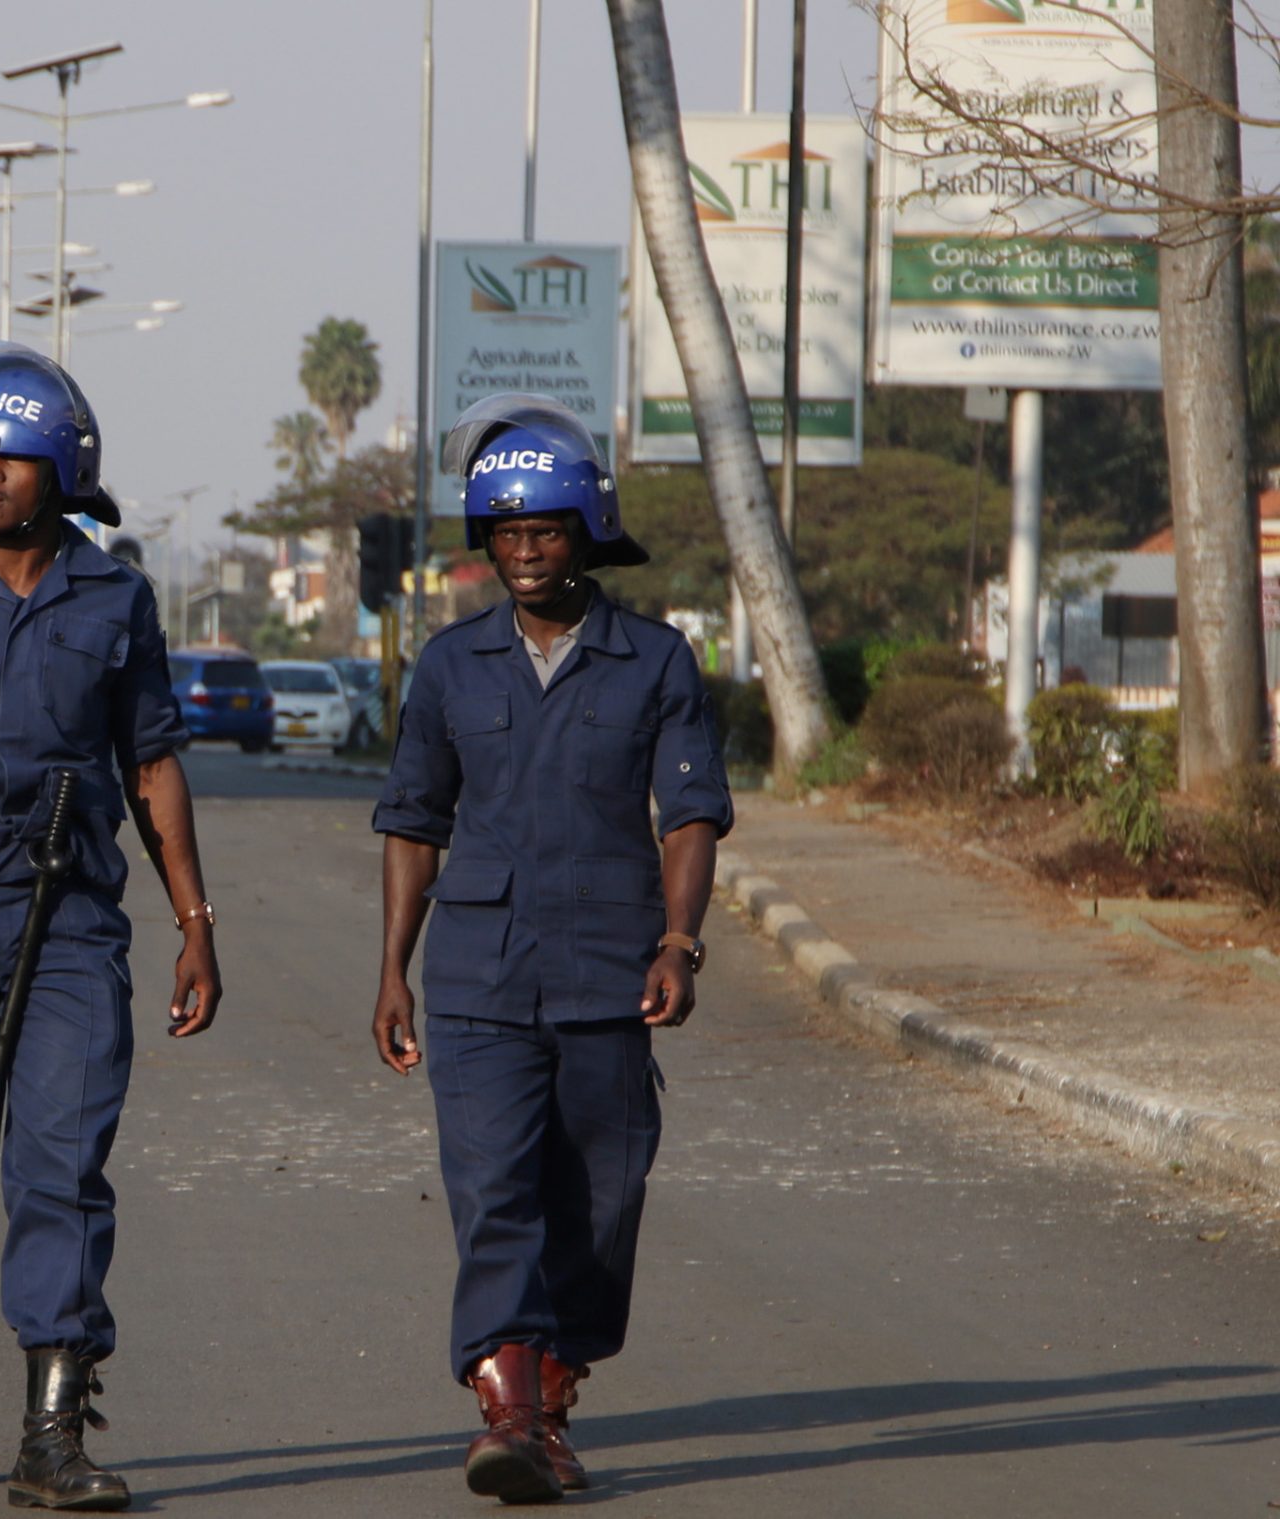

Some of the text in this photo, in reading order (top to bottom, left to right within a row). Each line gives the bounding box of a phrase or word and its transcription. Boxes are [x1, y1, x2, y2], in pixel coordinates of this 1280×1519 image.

[1109, 90, 1133, 117] &
[730, 161, 833, 210] THI
[930, 243, 1010, 267] Contact
[1016, 244, 1063, 268] Your
[513, 268, 588, 304] THI
[932, 270, 1139, 297] or Contact Us Direct
[468, 348, 560, 369] Agricultural
[458, 370, 589, 389] General Insurers
[471, 450, 555, 481] POLICE
